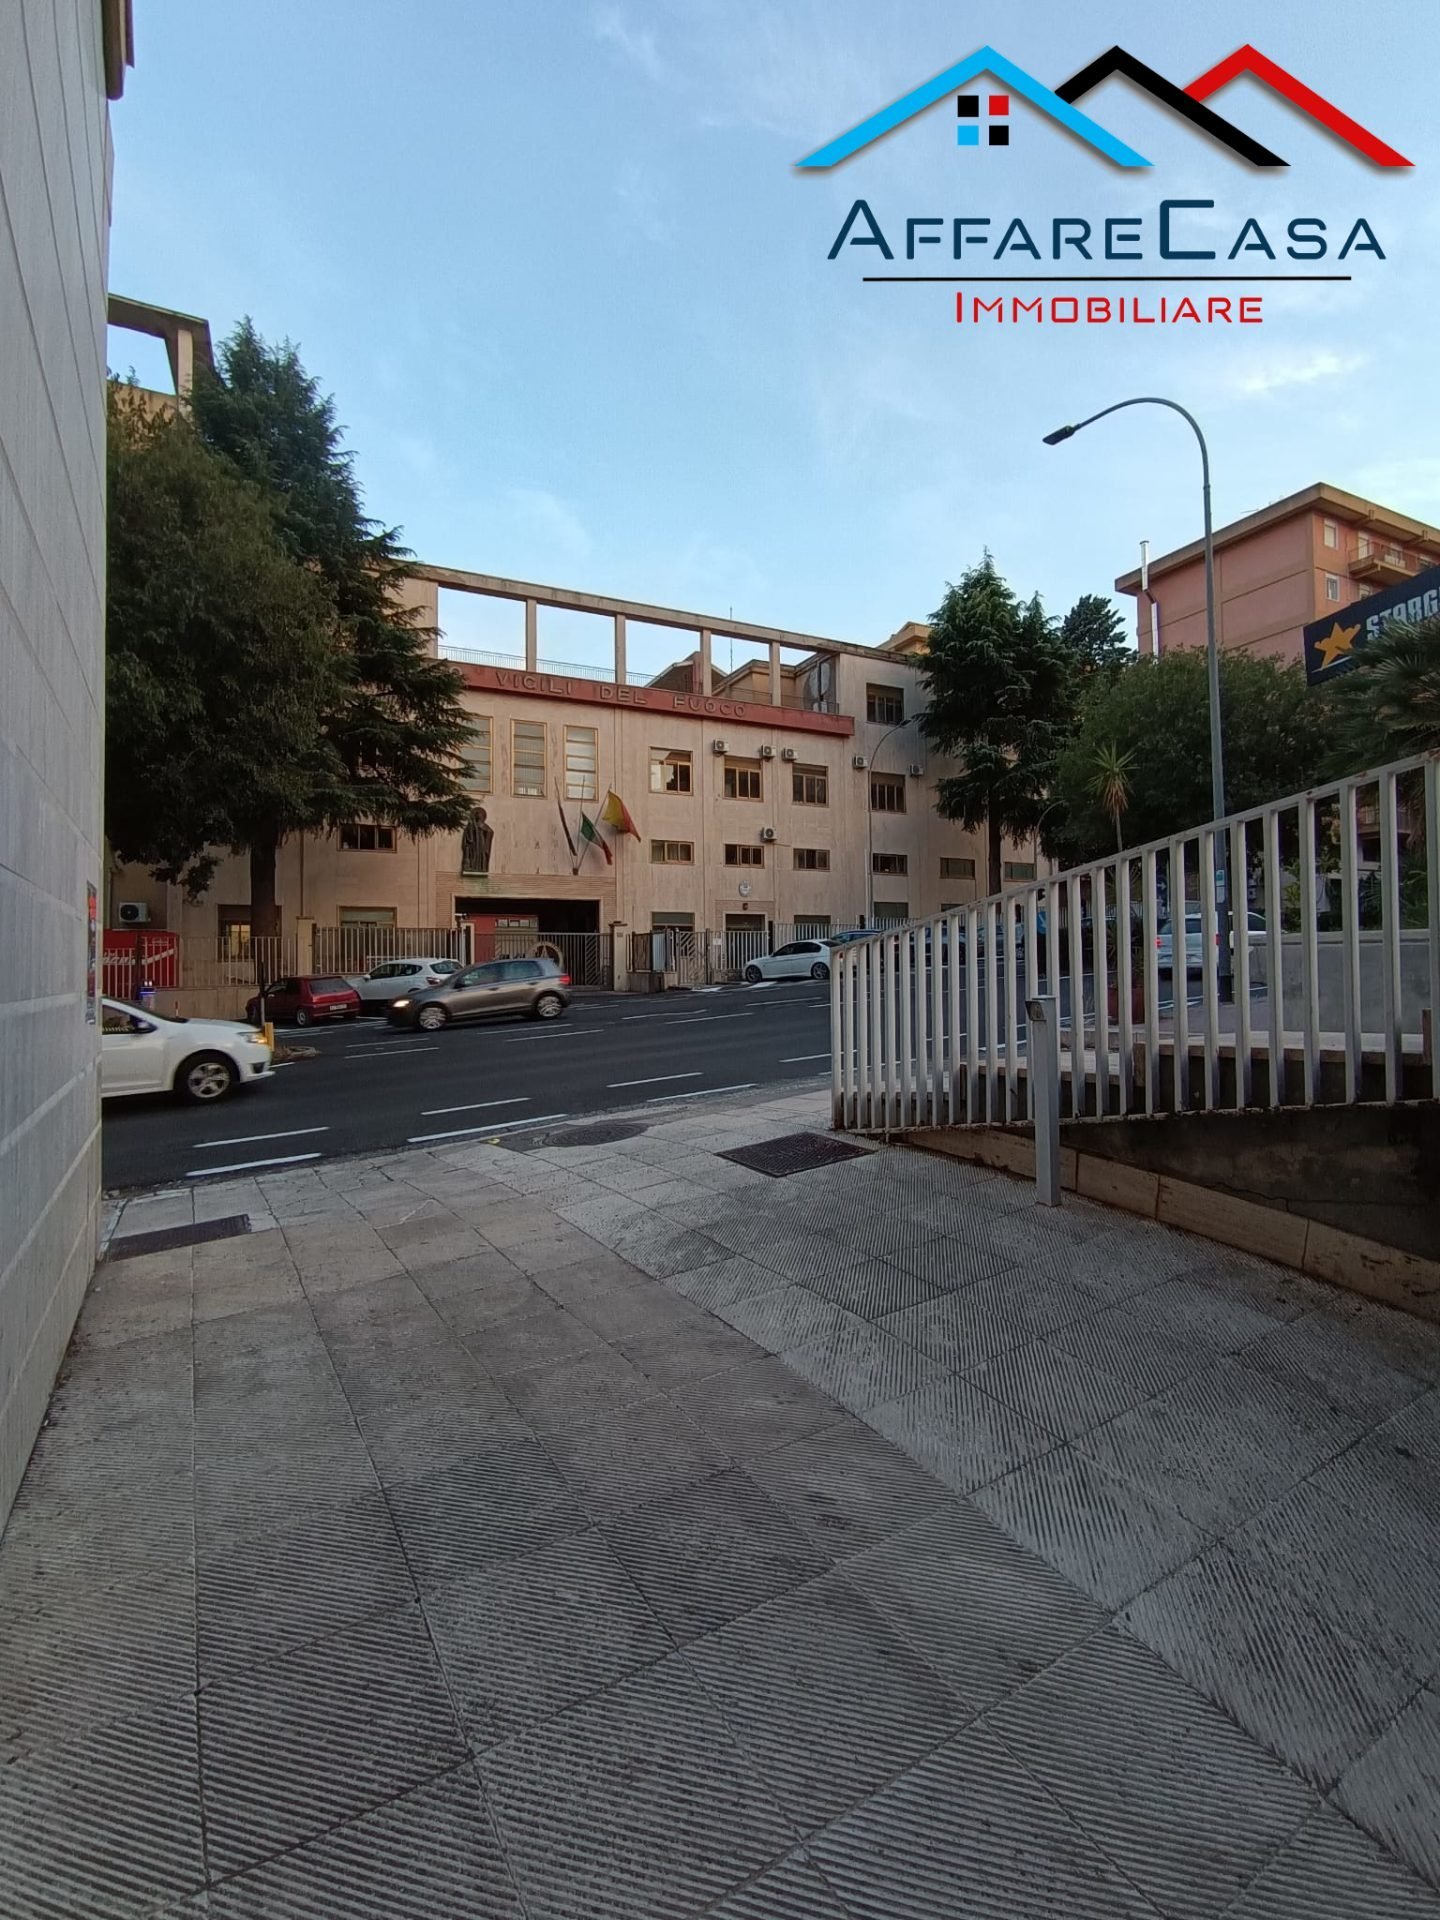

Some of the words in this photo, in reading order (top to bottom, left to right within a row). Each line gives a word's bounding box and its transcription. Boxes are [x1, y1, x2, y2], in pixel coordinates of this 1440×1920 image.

[1366, 586, 1440, 641] STARG
[600, 685, 648, 705] DEL
[672, 694, 746, 718] FUOCO
